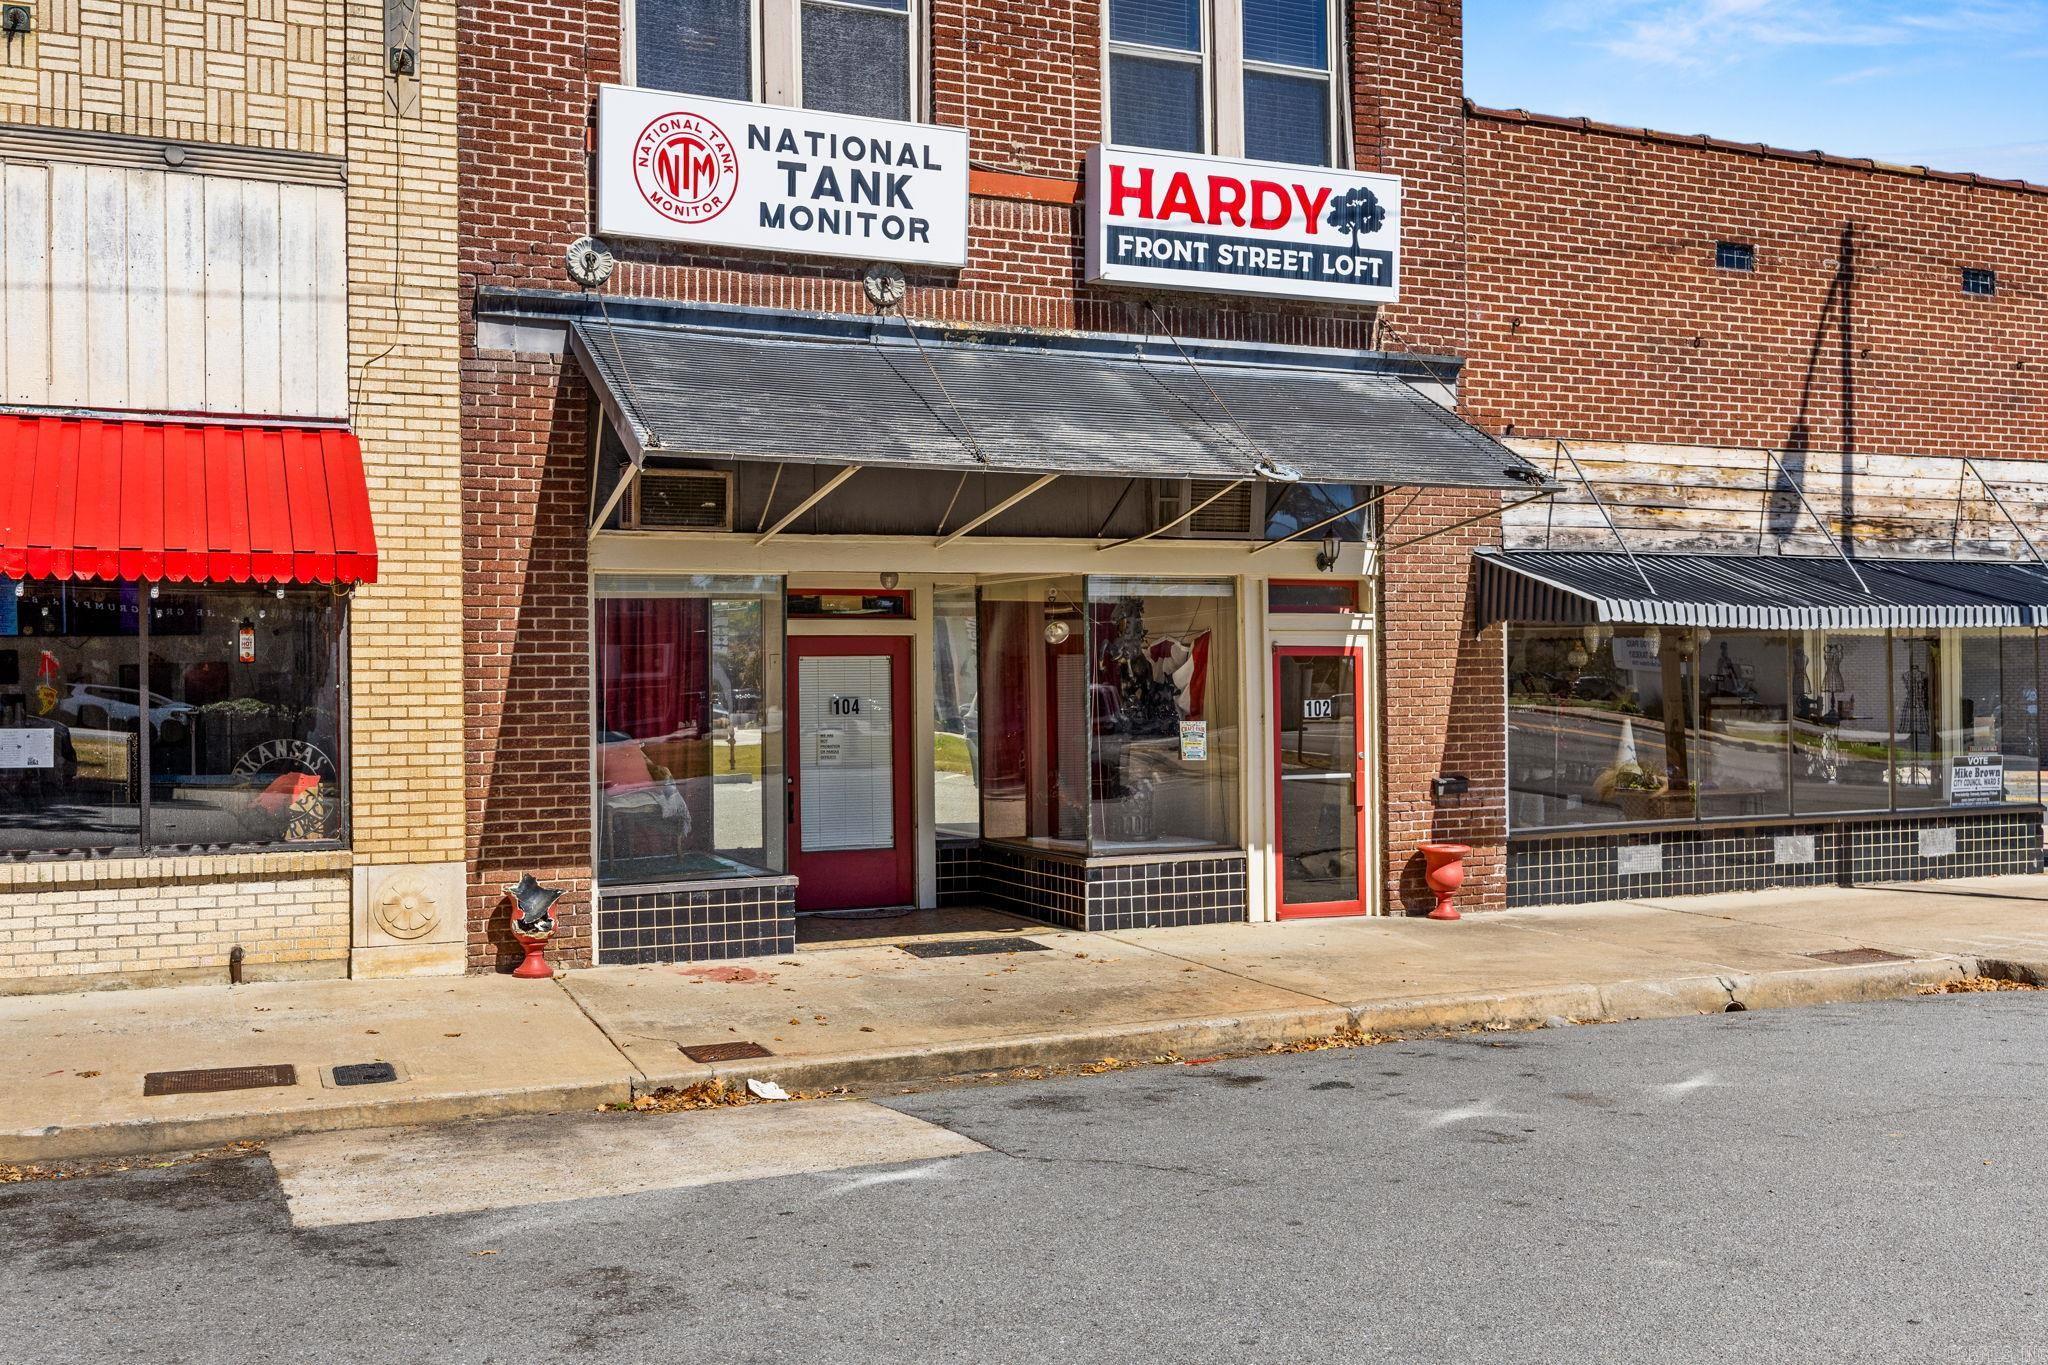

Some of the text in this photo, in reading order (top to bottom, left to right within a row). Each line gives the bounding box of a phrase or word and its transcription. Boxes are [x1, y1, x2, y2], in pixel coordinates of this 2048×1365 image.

[638, 118, 733, 174] NATIONAL TANK
[658, 136, 715, 199] NTM
[748, 124, 942, 171] NATIONAL
[650, 191, 724, 217] MONITOR
[777, 160, 914, 210] TANK
[1108, 164, 1333, 235] HARDY
[759, 201, 930, 244] MONITOR
[1118, 235, 1383, 278] FRONT STREET LOFT
[834, 698, 859, 714] 104
[1306, 700, 1330, 716] 102
[232, 739, 328, 784] RKANSAS
[1954, 767, 2001, 779] Mike Brown
[1968, 756, 1989, 765] VOTE
